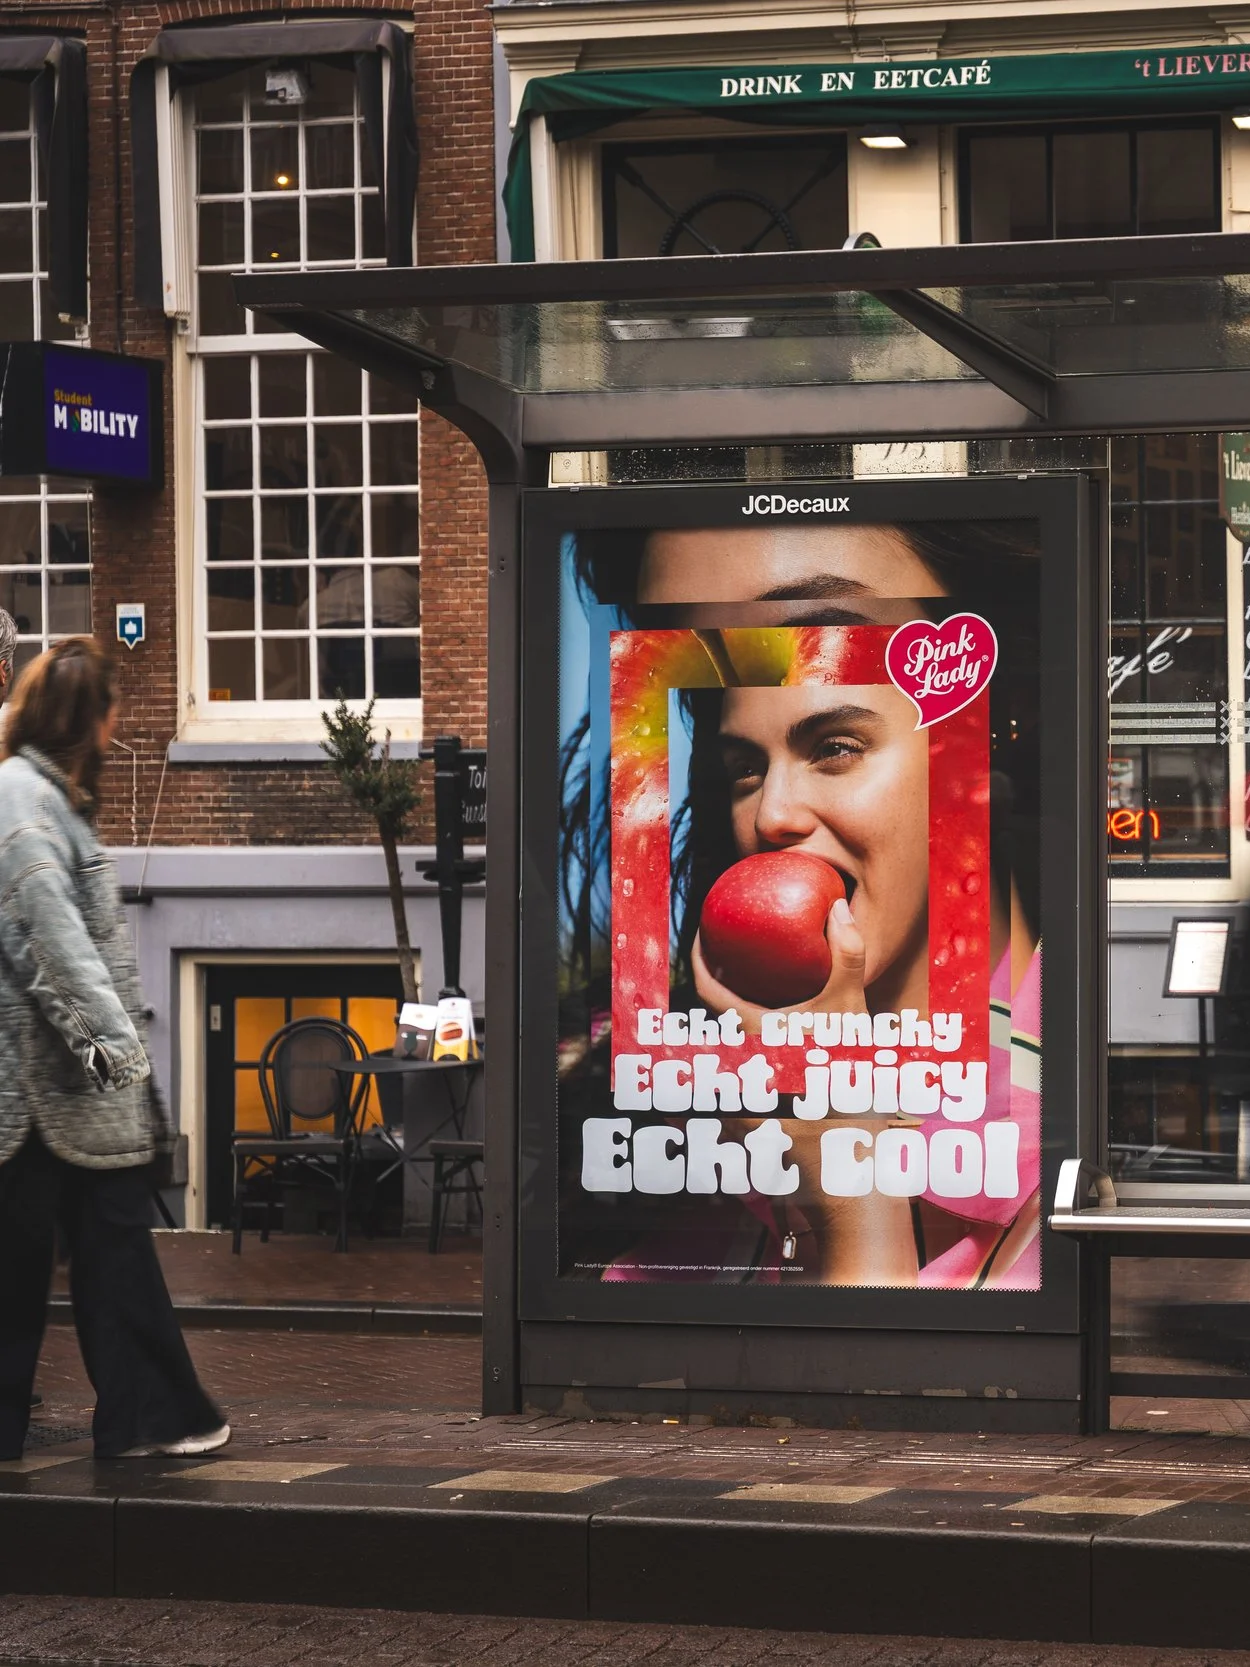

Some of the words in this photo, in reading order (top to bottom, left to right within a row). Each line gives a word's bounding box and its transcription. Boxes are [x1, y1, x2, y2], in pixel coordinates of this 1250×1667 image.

[720, 75, 802, 97] DRINK
[820, 72, 855, 92] EN
[873, 60, 991, 90] EETCAFÉ
[54, 388, 92, 406] Student
[742, 494, 850, 516] JCDecaux
[904, 624, 976, 676] Pink
[1107, 808, 1160, 841] en
[638, 1008, 745, 1046] Echt
[761, 1008, 962, 1052] crunchy
[614, 1054, 778, 1112] Echt
[793, 1049, 988, 1122] juicy
[581, 1117, 799, 1196] Echt
[821, 1121, 1020, 1198] cool
